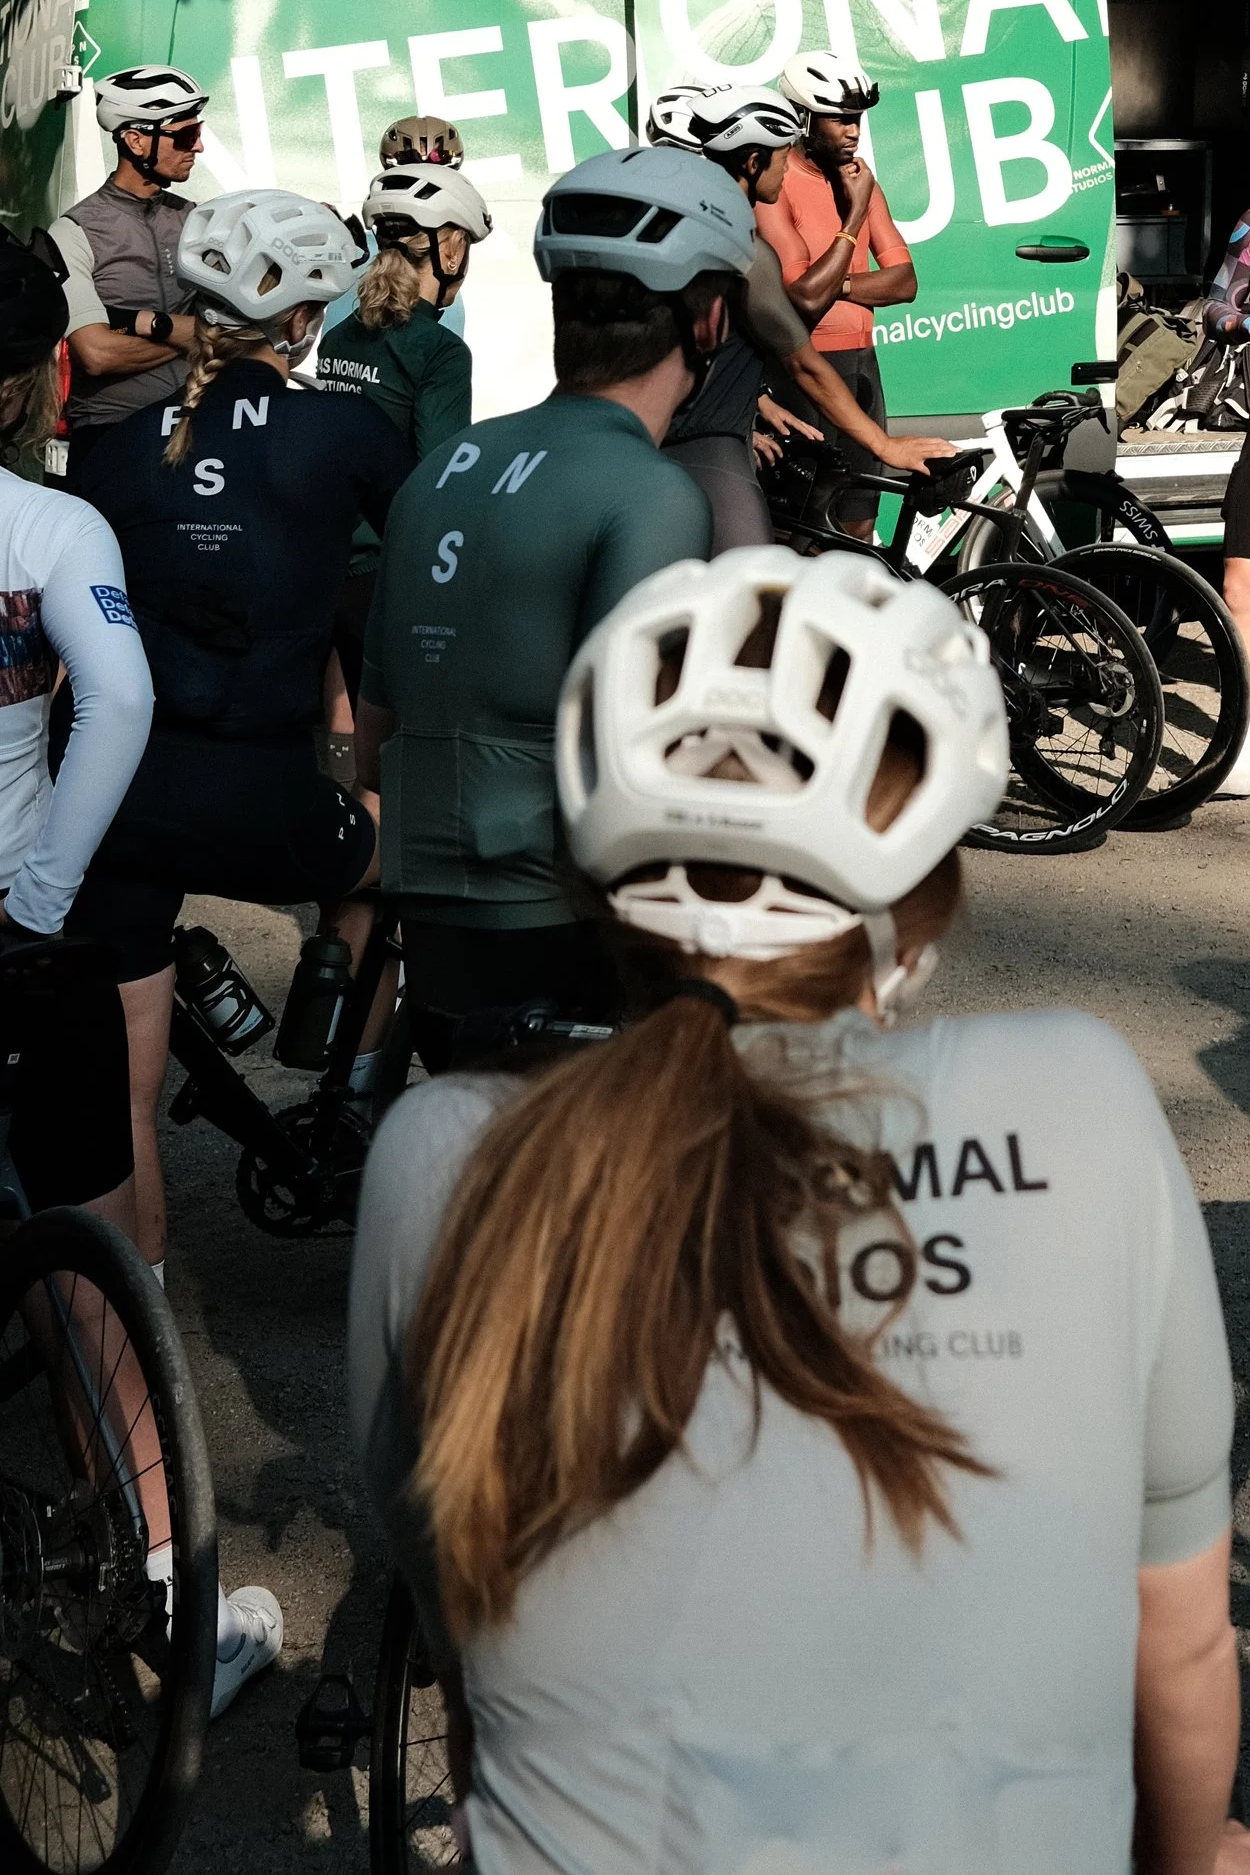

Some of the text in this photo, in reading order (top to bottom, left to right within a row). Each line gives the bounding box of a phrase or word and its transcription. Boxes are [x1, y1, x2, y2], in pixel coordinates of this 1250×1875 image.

[1072, 172, 1113, 193] TUDIOS
[332, 358, 380, 384] NORMAL
[232, 396, 270, 430] N
[193, 458, 226, 496] S
[435, 441, 548, 494] P N
[176, 523, 244, 532] INTERNATIONAL
[1119, 500, 1159, 540] SWISS
[190, 533, 229, 542] CYCLING
[197, 543, 221, 552] CLUB
[431, 530, 464, 584] S
[947, 1330, 1025, 1361] CLUB
